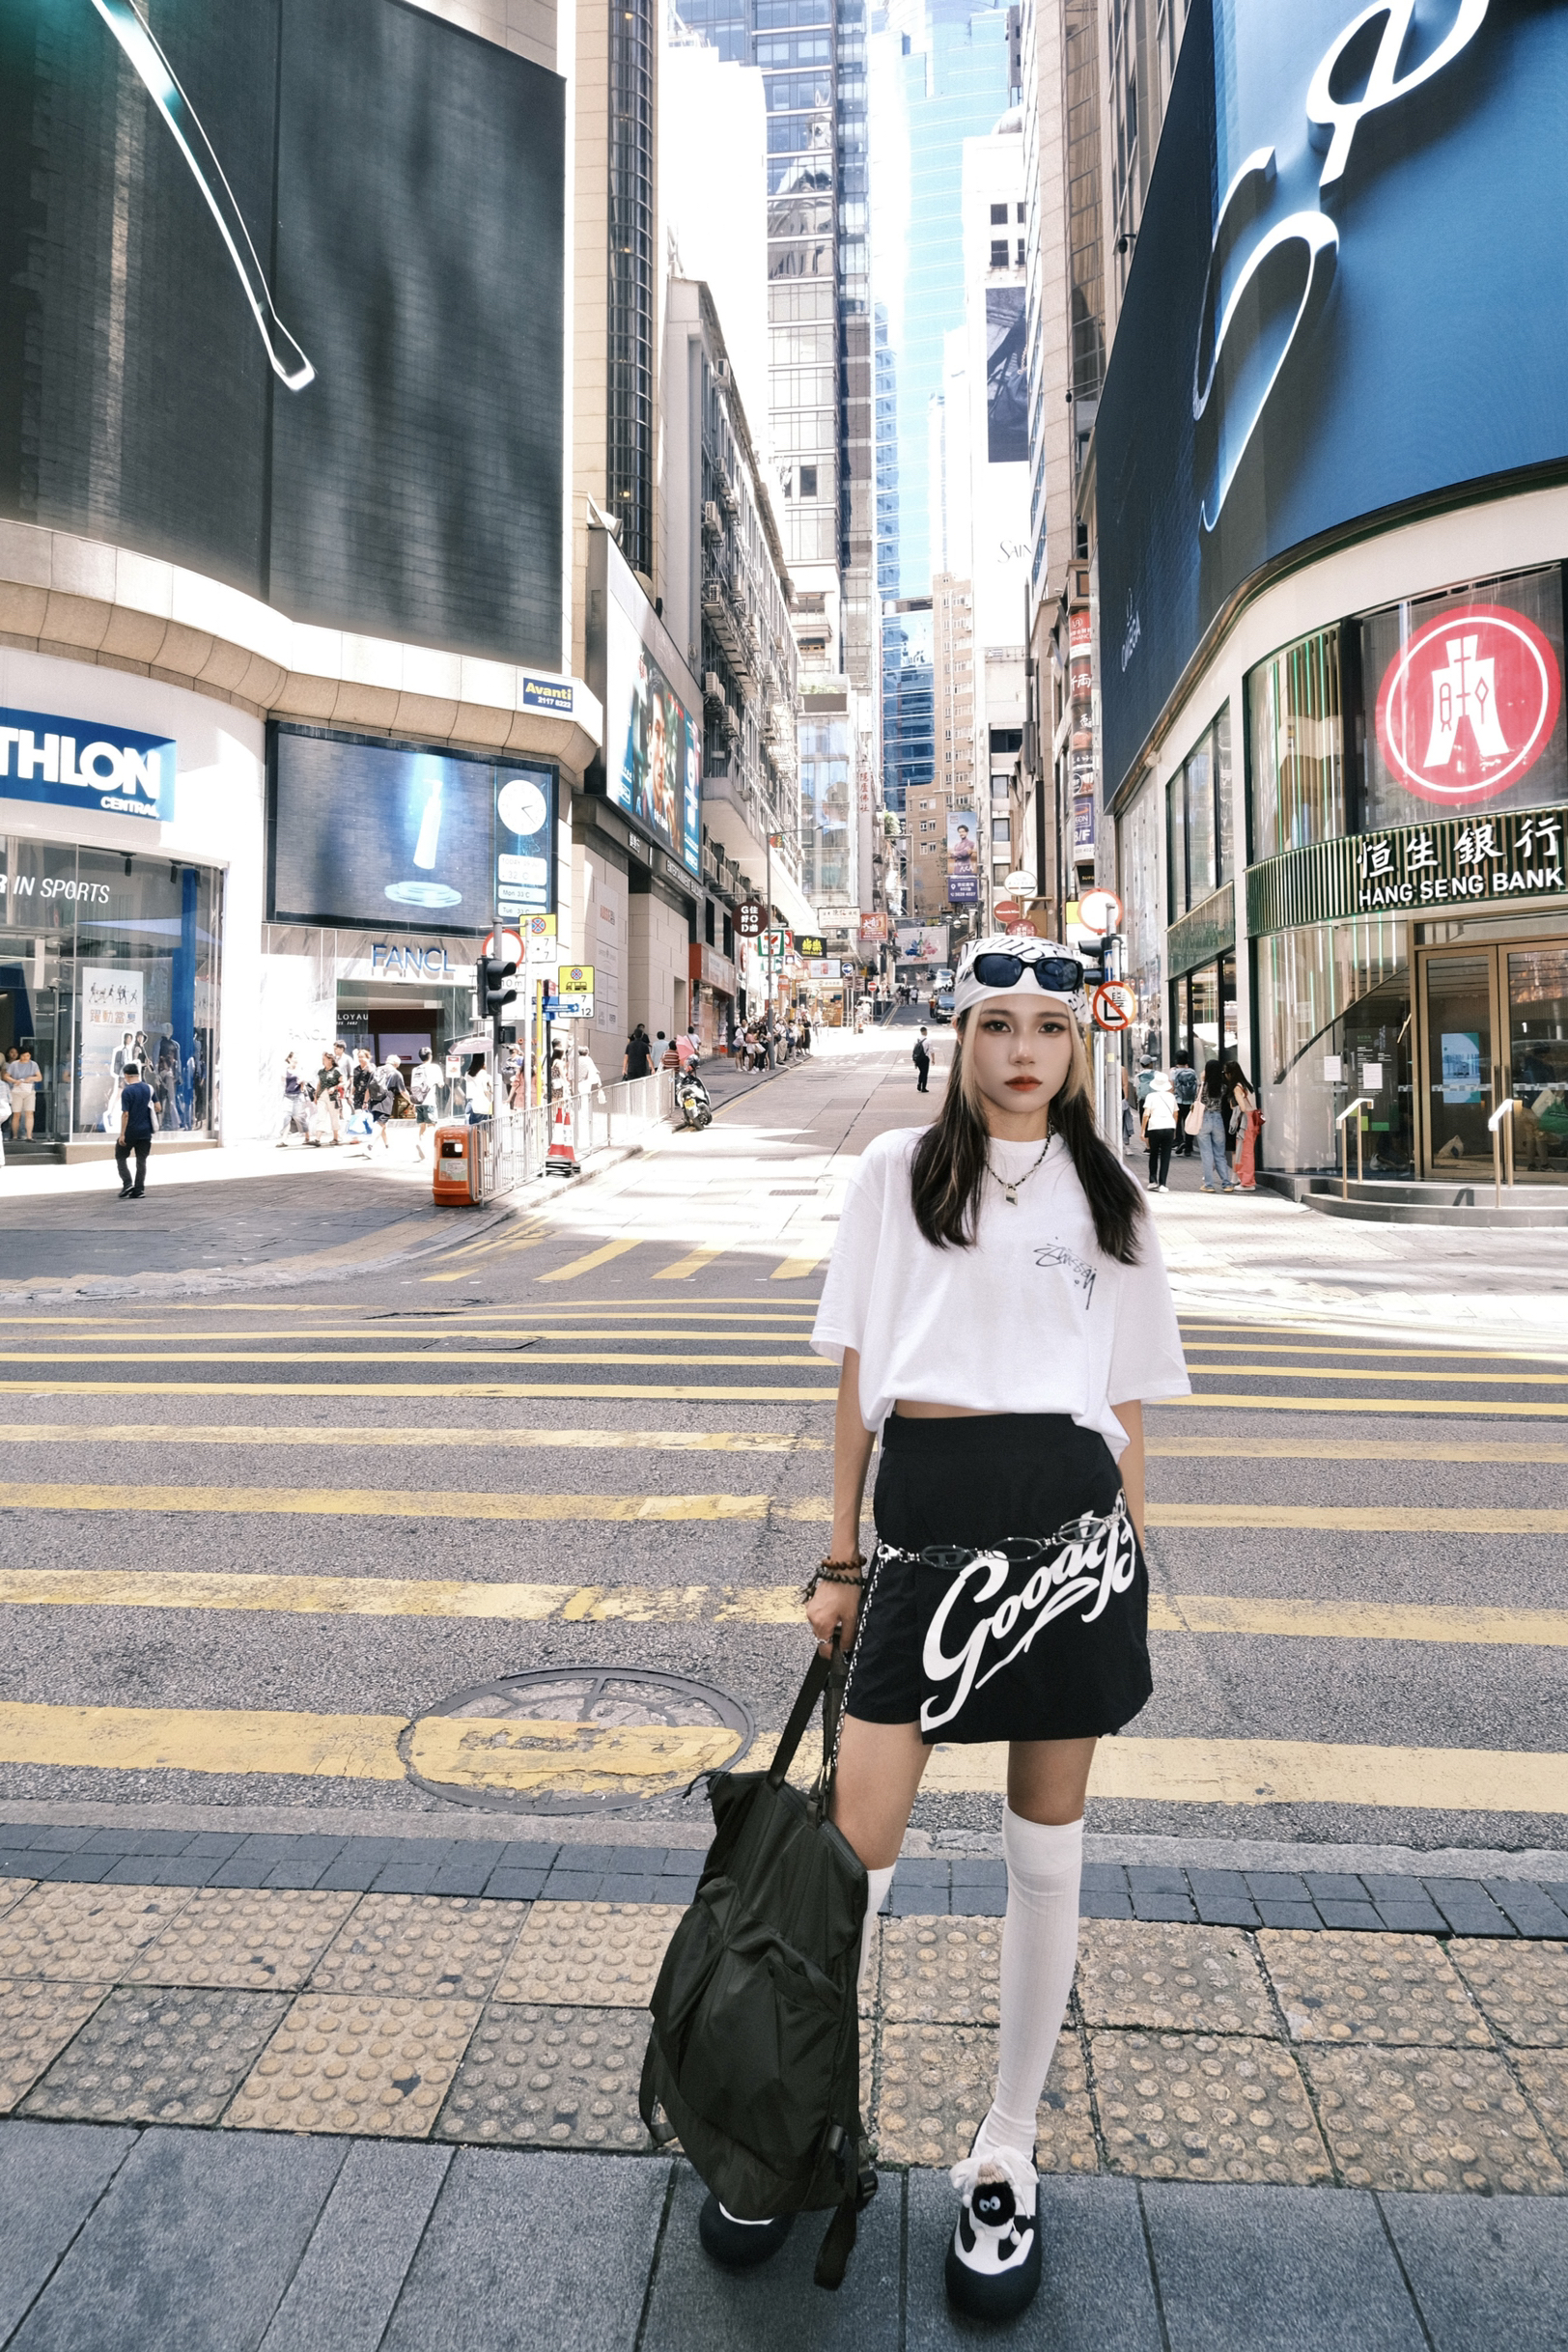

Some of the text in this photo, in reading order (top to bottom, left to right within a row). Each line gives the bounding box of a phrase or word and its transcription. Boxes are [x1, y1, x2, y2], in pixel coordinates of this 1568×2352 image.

[525, 682, 572, 701] Avanti
[100, 796, 160, 819] CENTRAL
[1357, 817, 1562, 880] 恒生銀行
[14, 875, 35, 896] IN
[41, 878, 110, 904] SPORTS
[1358, 866, 1565, 908] HANG SENG BANK
[371, 942, 456, 973] FANCL
[581, 994, 587, 1003] 7
[581, 1008, 592, 1017] 12
